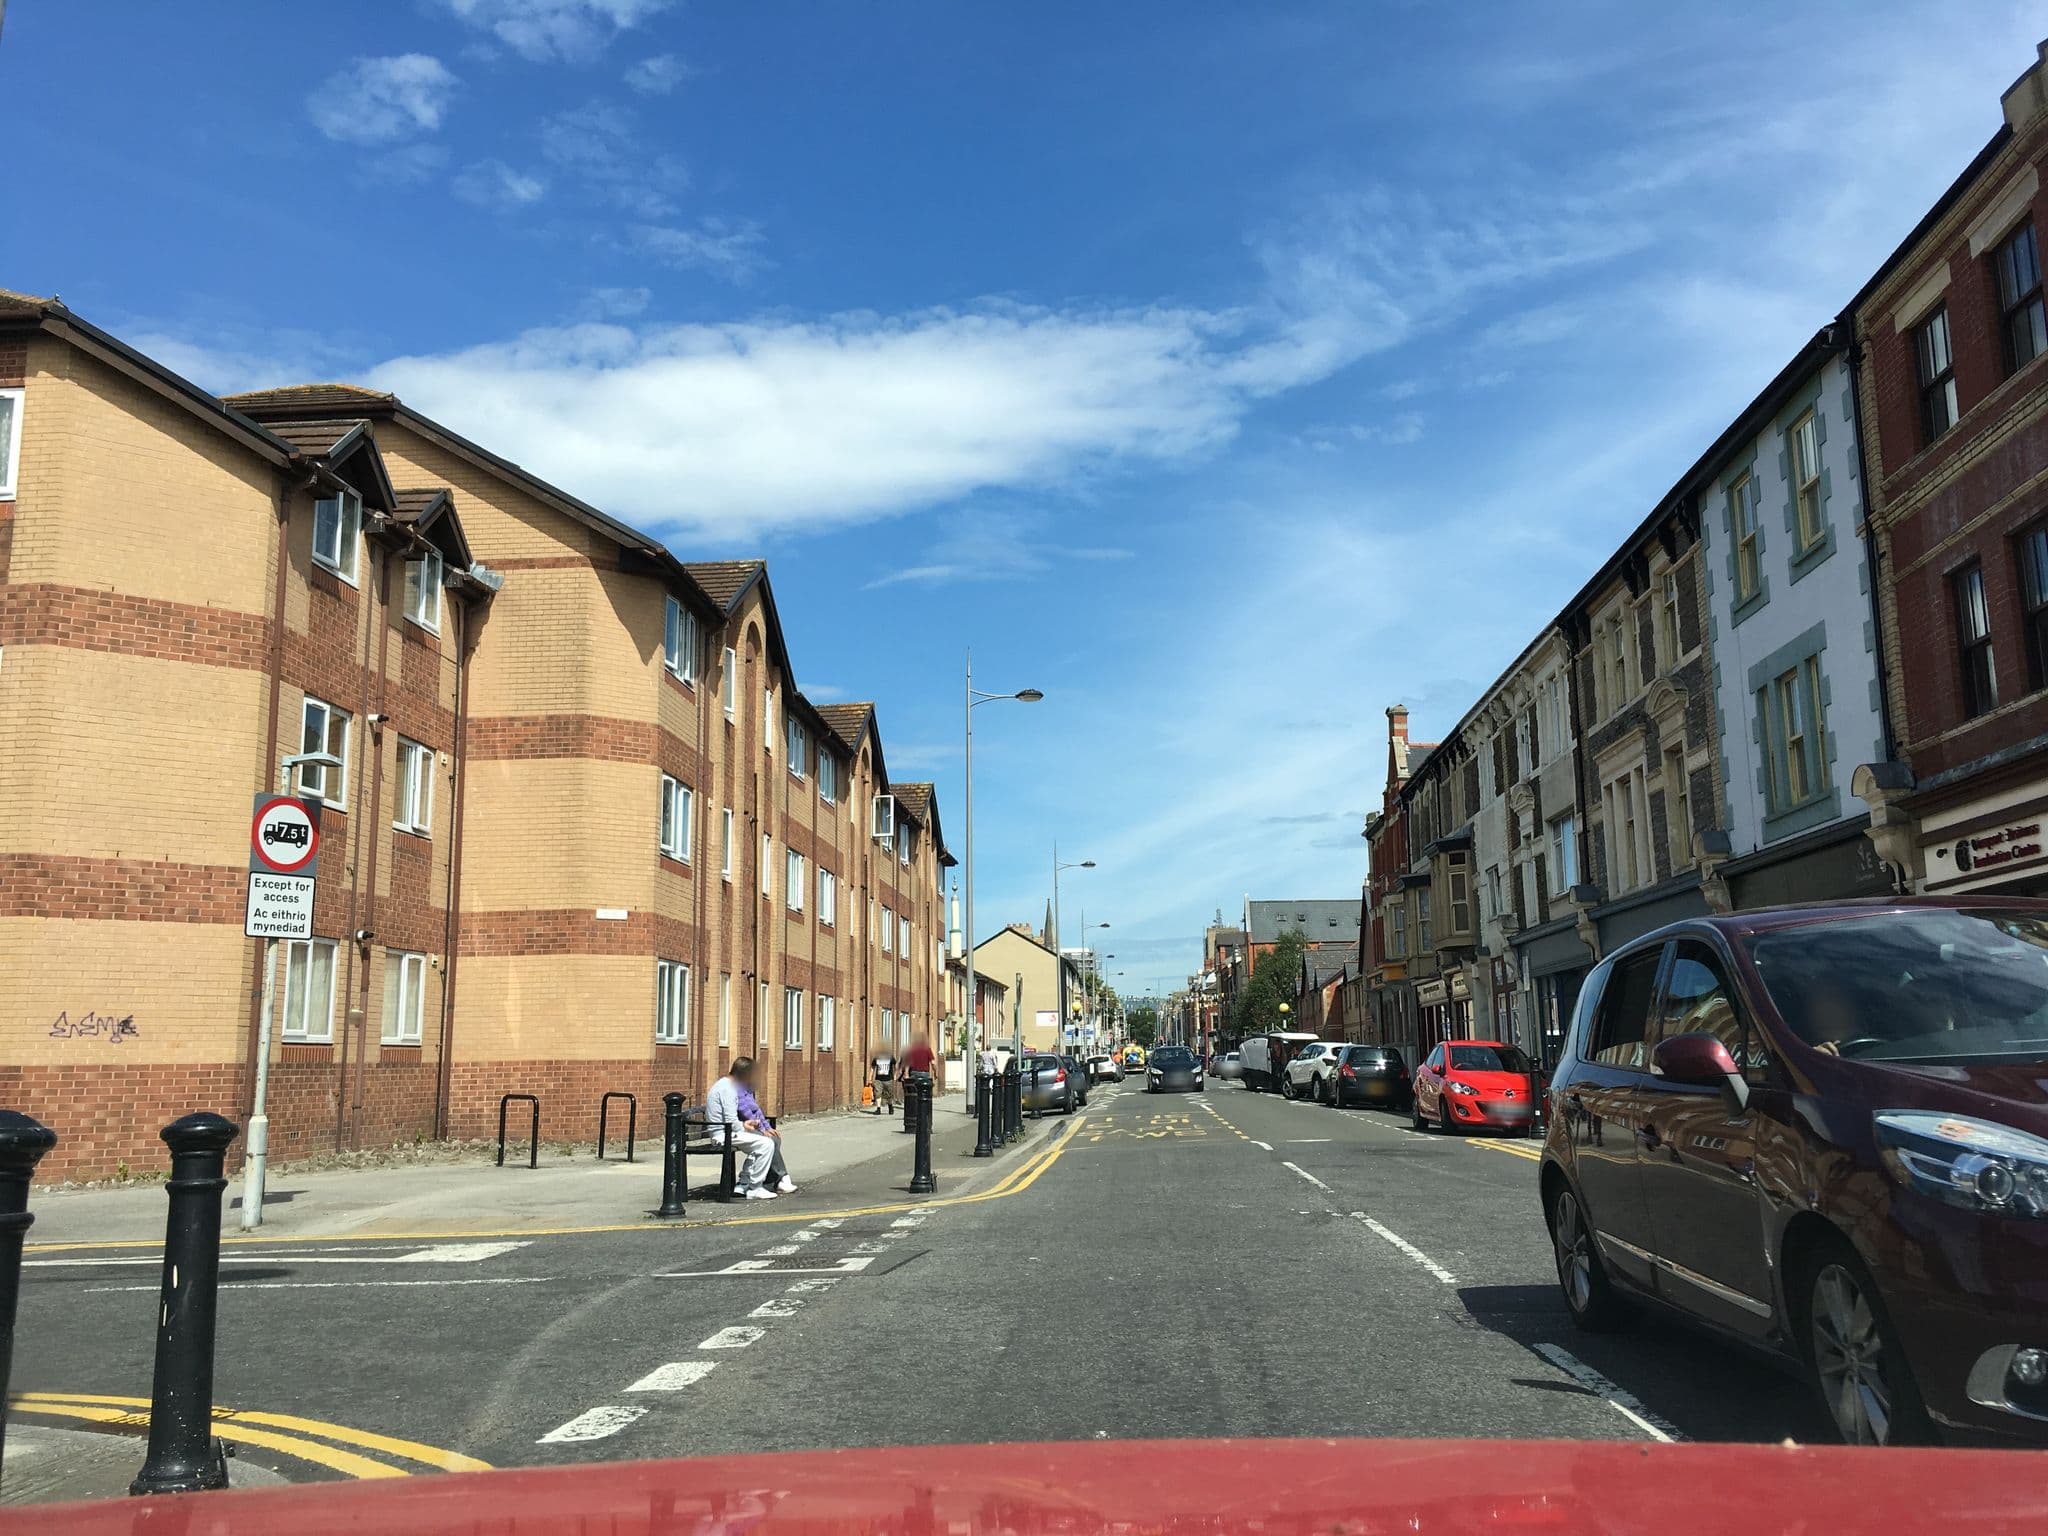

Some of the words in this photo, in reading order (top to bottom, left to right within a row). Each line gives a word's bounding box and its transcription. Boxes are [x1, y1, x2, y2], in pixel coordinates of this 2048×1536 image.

[254, 878, 292, 891] Except
[295, 882, 310, 892] for
[263, 894, 300, 904] access
[254, 908, 268, 918] Ac
[271, 909, 306, 921] eithrio
[253, 923, 305, 934] mynediad
